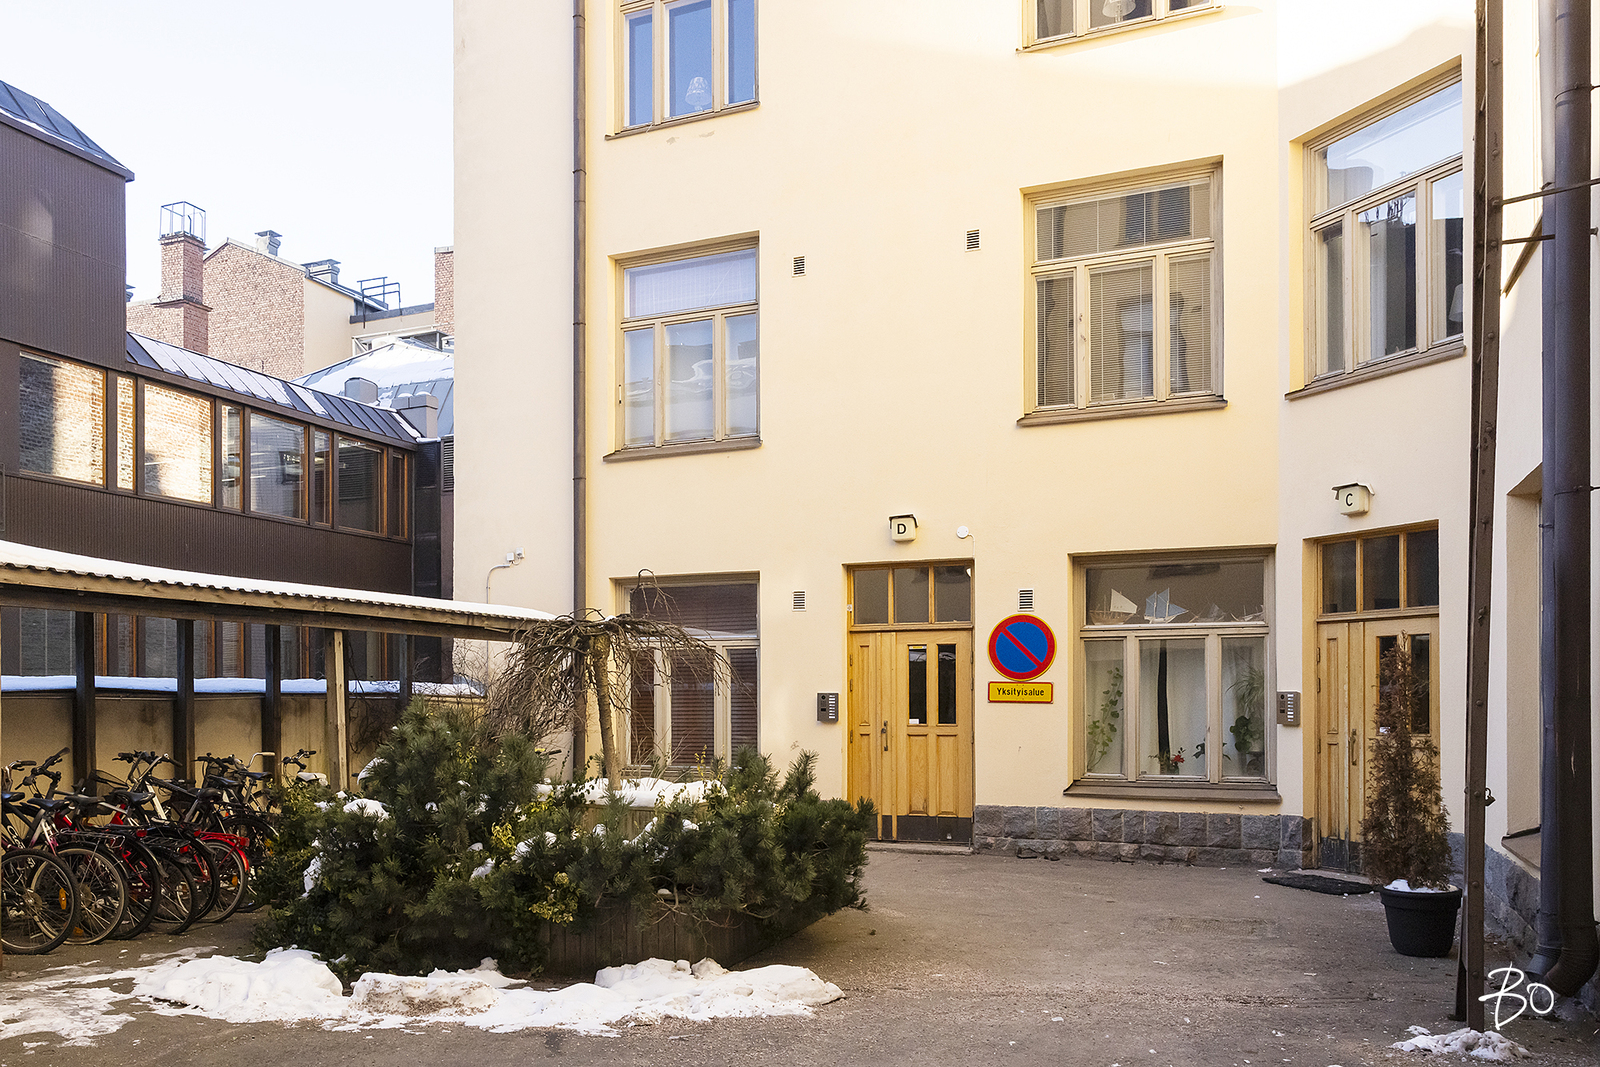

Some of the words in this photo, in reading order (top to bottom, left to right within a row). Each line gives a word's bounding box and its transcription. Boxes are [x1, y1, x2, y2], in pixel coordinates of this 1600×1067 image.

[1345, 493, 1353, 507] C
[897, 523, 907, 535] D
[996, 687, 1045, 697] Yksityisalue
